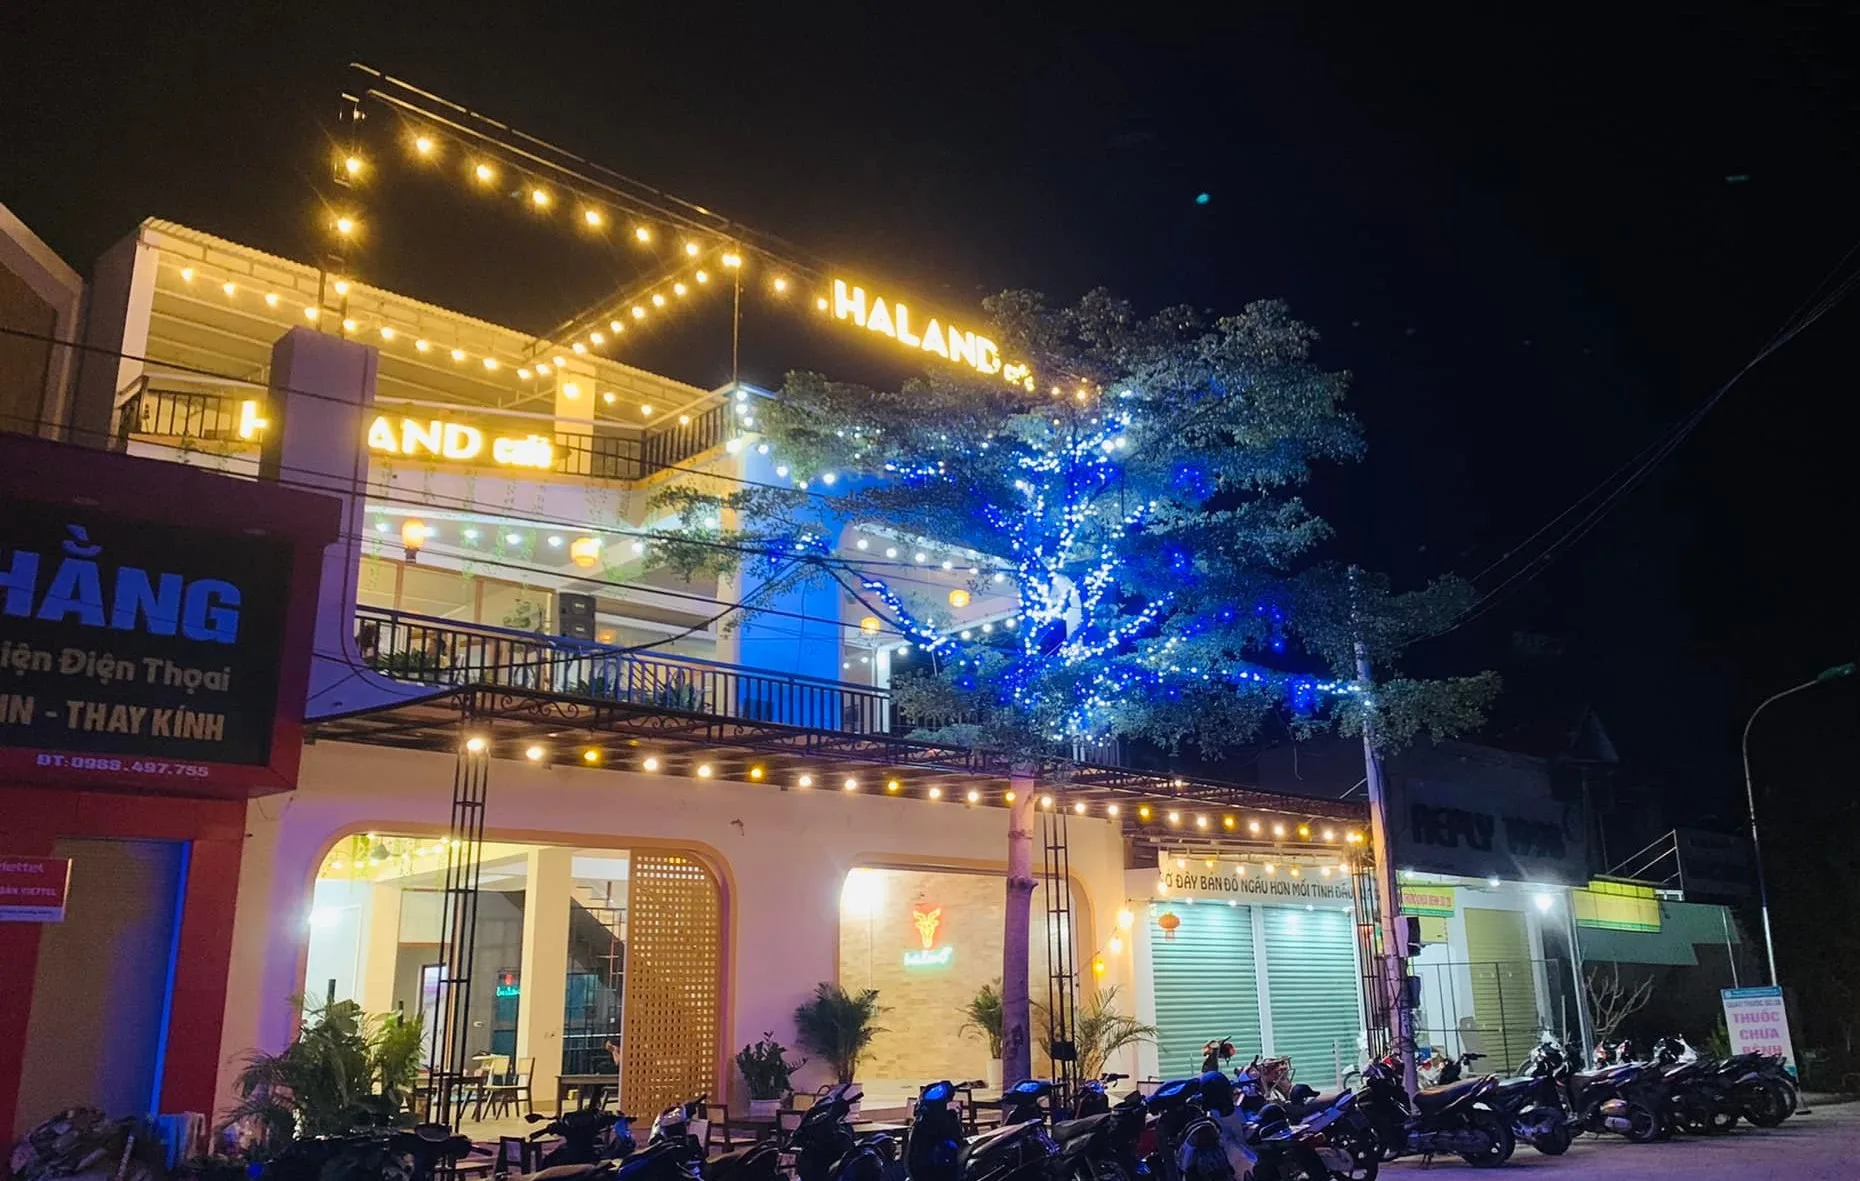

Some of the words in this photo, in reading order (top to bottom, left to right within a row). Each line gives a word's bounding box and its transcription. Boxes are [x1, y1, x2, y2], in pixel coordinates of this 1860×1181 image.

[834, 279, 1001, 374] HALAND
[58, 648, 136, 686] Điện
[143, 657, 231, 695] Thoại
[67, 700, 147, 735] THAY
[151, 704, 224, 742] KÍNH
